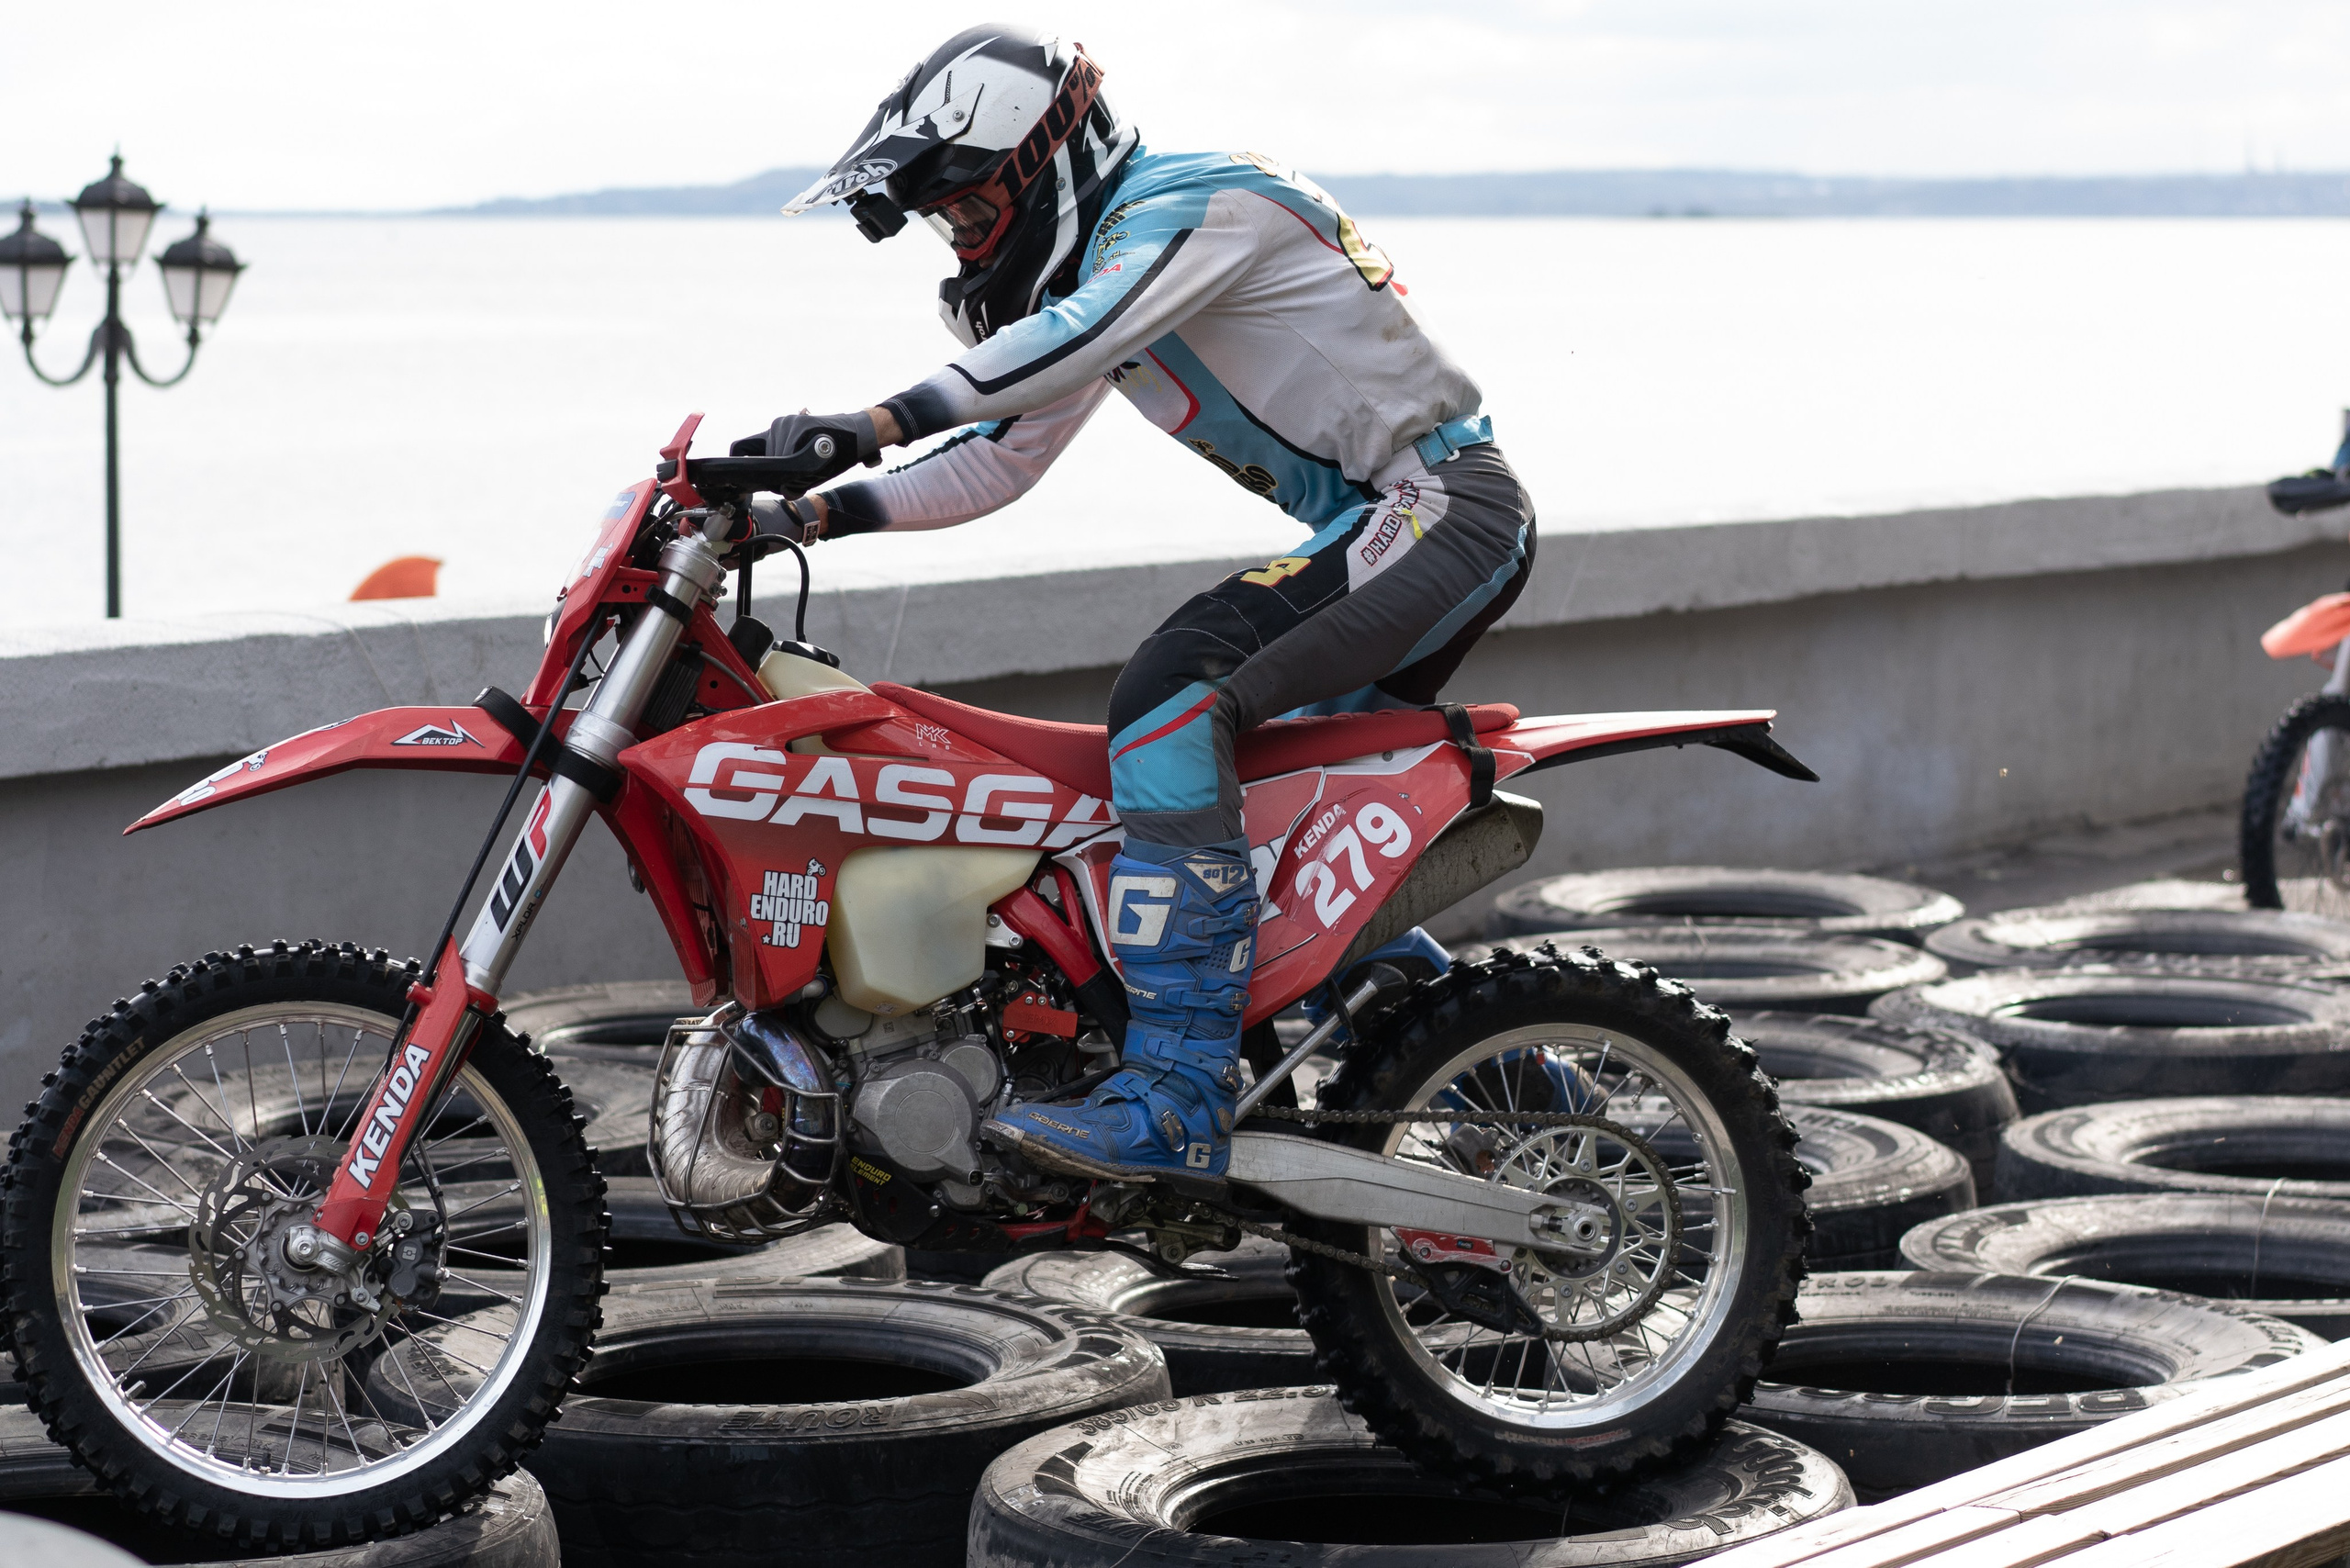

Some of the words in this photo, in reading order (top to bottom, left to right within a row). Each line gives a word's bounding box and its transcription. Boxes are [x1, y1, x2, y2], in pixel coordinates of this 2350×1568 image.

[995, 63, 1096, 200] 100%
[1293, 803, 1347, 859] KENDA
[1295, 801, 1412, 929] 279
[764, 871, 817, 900] HARD
[511, 902, 536, 941] XPLOR
[751, 894, 828, 926] ENDURO
[52, 1105, 85, 1159] KENDA
[78, 1036, 147, 1110] GAUNTLET
[348, 1044, 432, 1190] KENDA
[1028, 1112, 1091, 1139] GAERNE
[851, 1156, 891, 1182] ENDURO
[719, 1404, 893, 1431] ROUTE
[1069, 1396, 1181, 1436] 385/65
